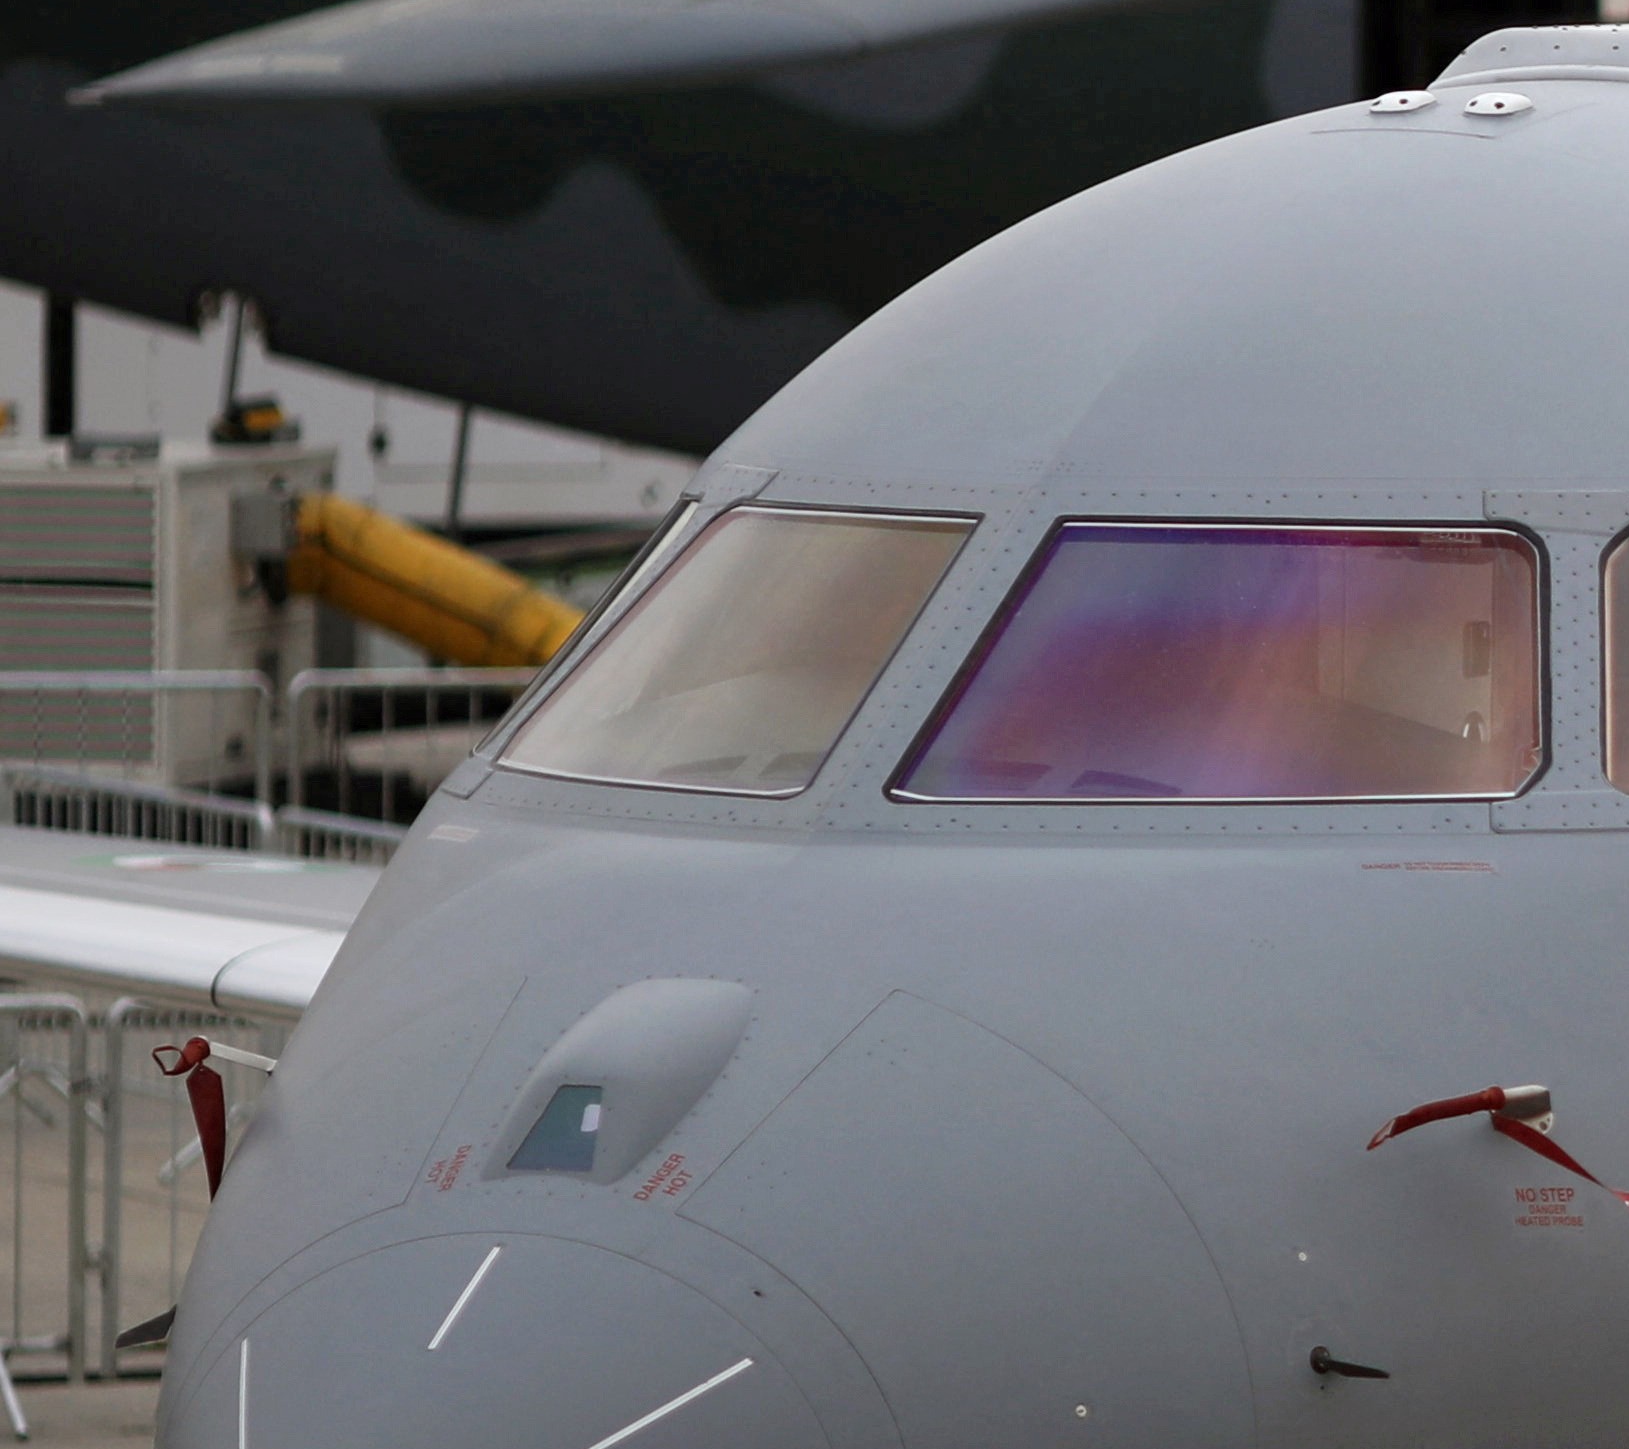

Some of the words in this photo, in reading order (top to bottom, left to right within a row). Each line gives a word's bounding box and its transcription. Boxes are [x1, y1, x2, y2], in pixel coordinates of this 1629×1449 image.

[633, 1152, 686, 1202] DANGER
[662, 1169, 694, 1198] HOT
[1515, 1187, 1536, 1202] NO
[1539, 1187, 1575, 1202] STEP
[1528, 1204, 1567, 1215] DANGER
[1514, 1216, 1550, 1227] HEATED
[1551, 1215, 1584, 1227] PROBE
